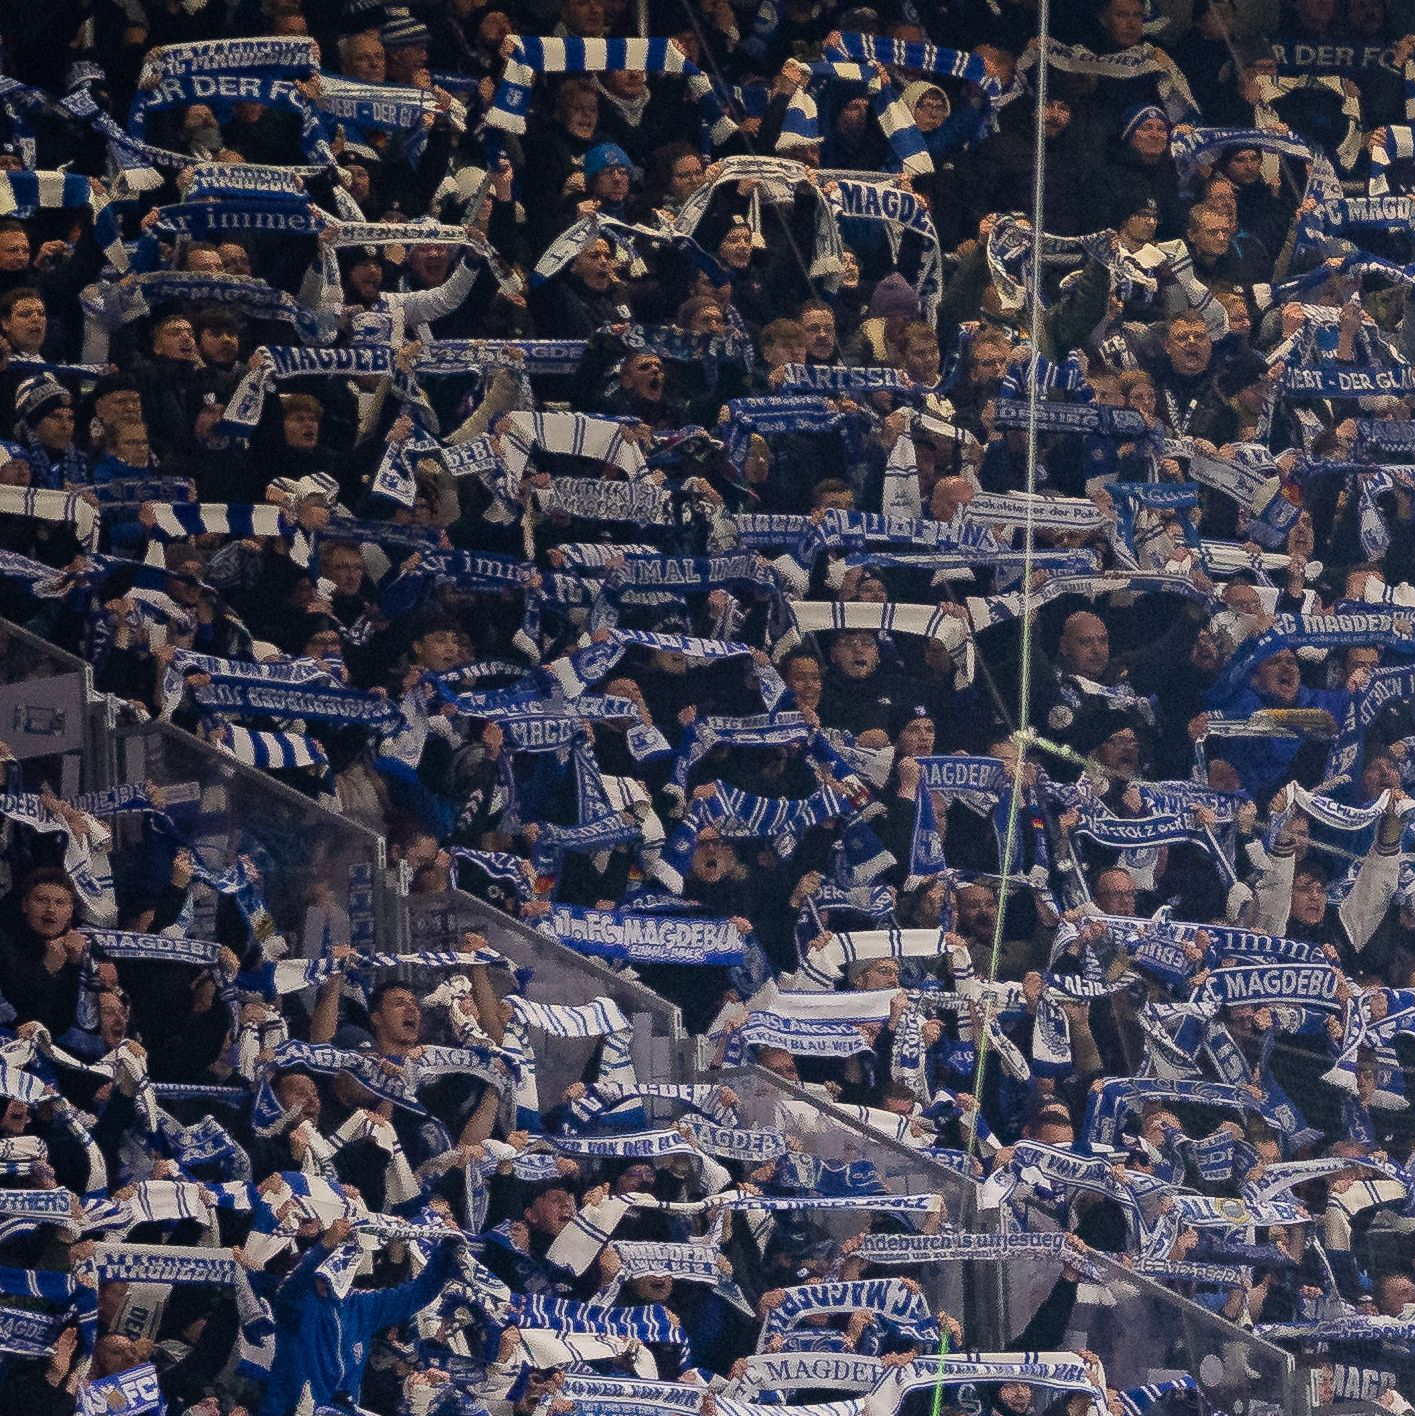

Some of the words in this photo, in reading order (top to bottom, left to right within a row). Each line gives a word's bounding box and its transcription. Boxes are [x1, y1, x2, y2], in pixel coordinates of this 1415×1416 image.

[1293, 46, 1357, 69] DER
[194, 75, 262, 101] DER
[1226, 967, 1338, 999] MAGDEBU
[126, 1378, 159, 1407] FC
